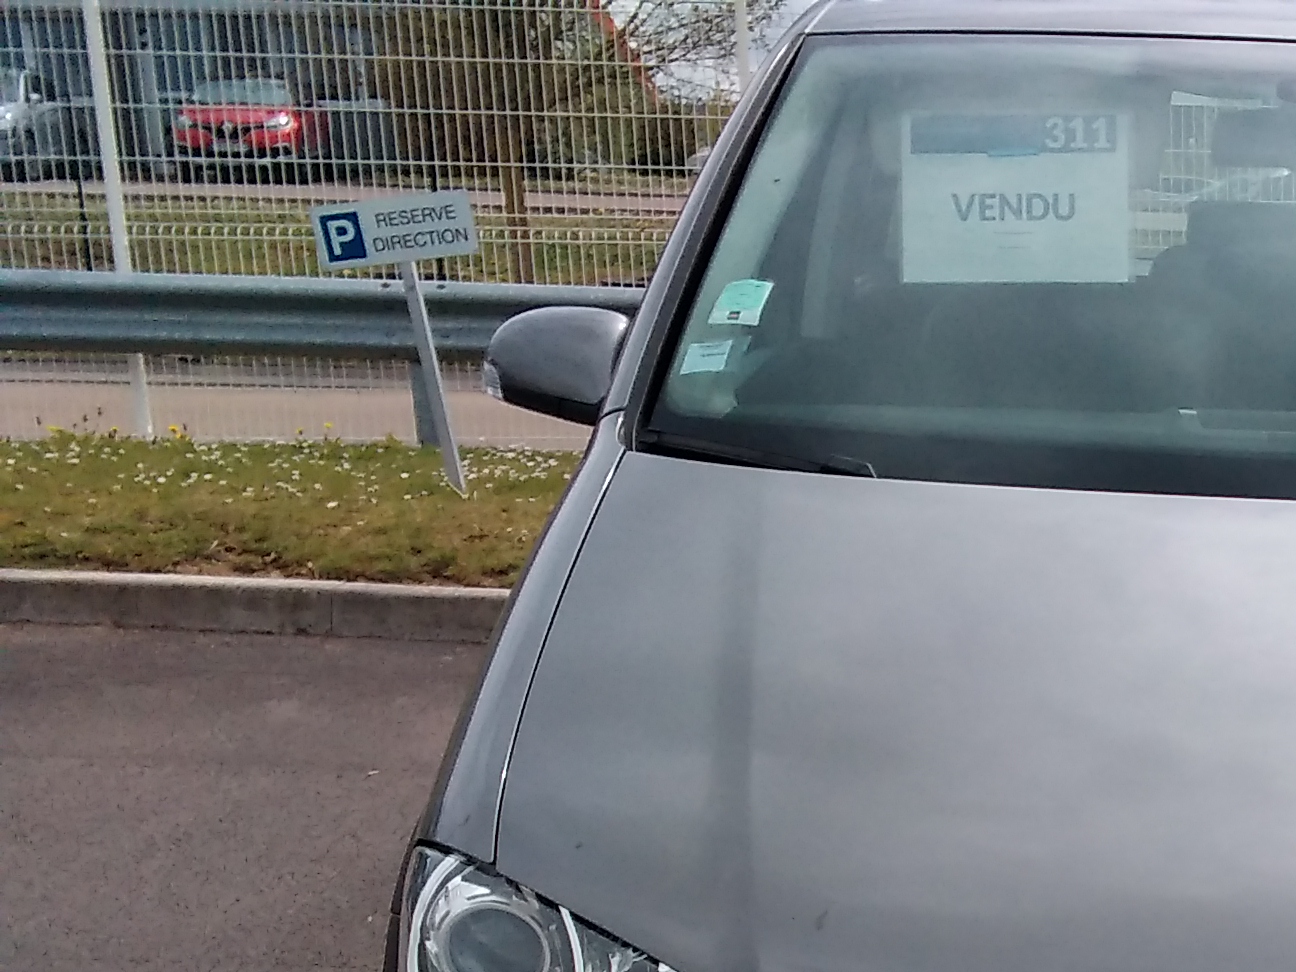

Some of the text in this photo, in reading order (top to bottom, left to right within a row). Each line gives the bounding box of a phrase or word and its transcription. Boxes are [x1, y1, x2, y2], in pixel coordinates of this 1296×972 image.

[1044, 116, 1111, 149] 311
[374, 204, 457, 228] RESERVE
[951, 193, 1075, 221] VENDU
[326, 219, 355, 256] P
[373, 228, 468, 252] DIRECTION
